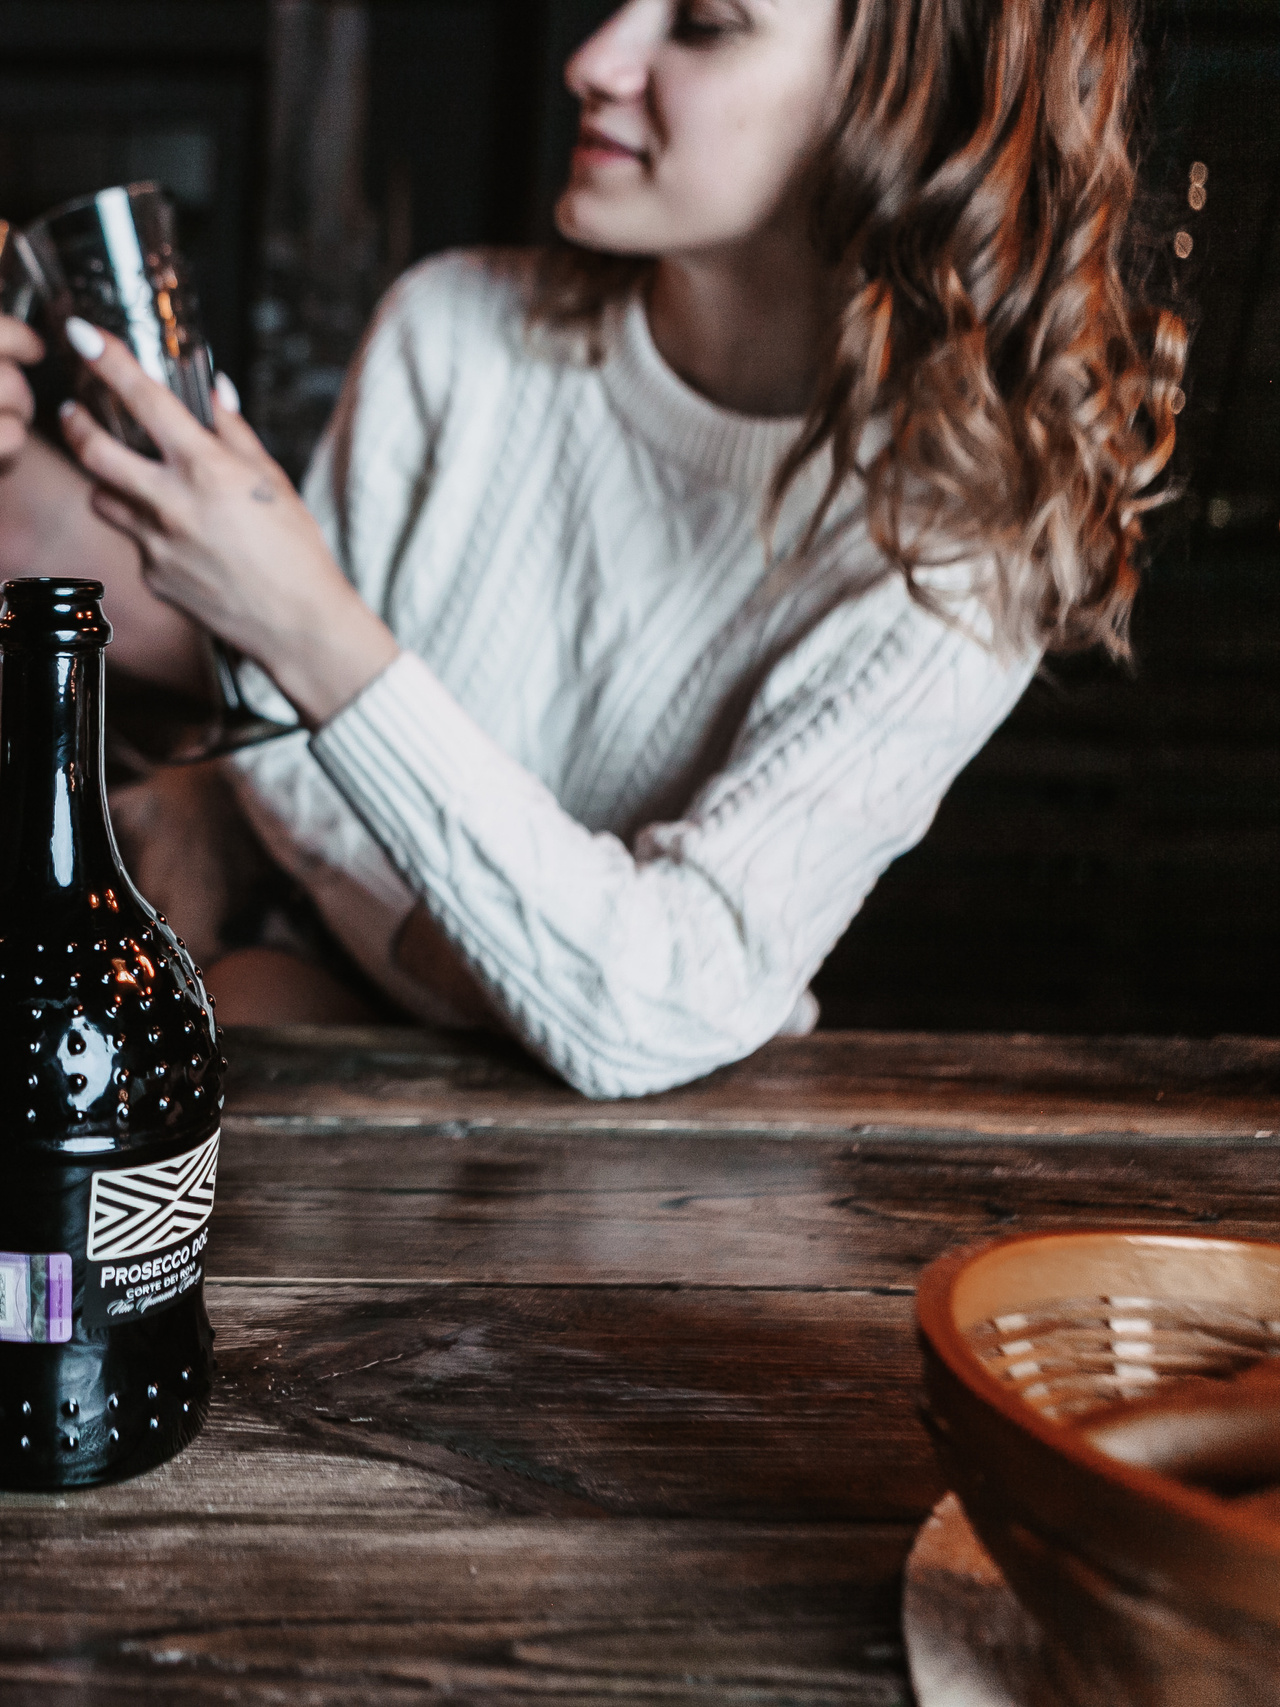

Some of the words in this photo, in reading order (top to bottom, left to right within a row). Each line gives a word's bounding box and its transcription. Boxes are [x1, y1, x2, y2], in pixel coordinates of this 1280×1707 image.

[100, 1246, 190, 1288] PROSECCO
[126, 1279, 162, 1300] CORTE
[163, 1273, 179, 1289] DEI
